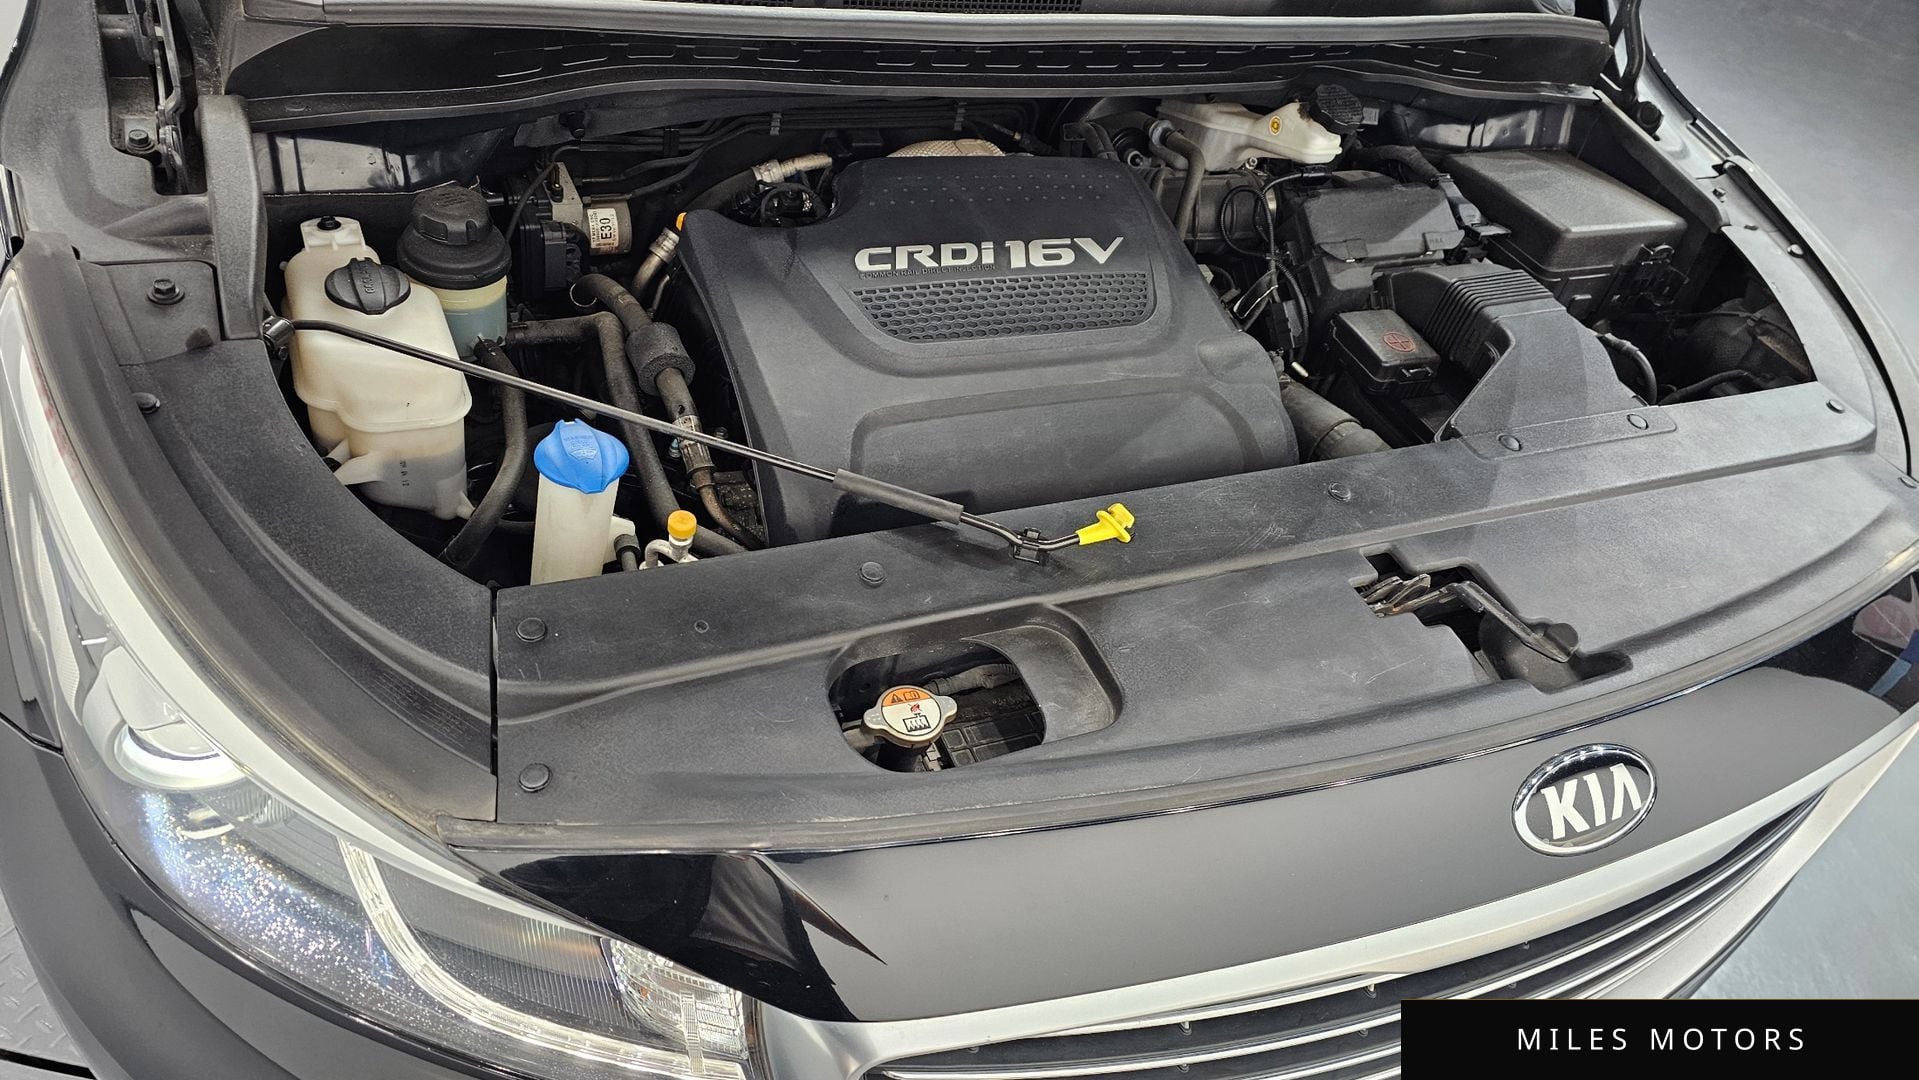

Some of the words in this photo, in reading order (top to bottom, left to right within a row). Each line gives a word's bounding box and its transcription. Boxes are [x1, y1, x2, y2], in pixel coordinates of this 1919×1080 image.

[599, 217, 612, 240] E30
[854, 241, 994, 271] CRDi
[1005, 236, 1124, 268] 16V
[860, 270, 899, 280] COMMON
[901, 269, 918, 278] RAIL
[922, 266, 951, 275] DIRECT
[1540, 763, 1642, 840] KIA
